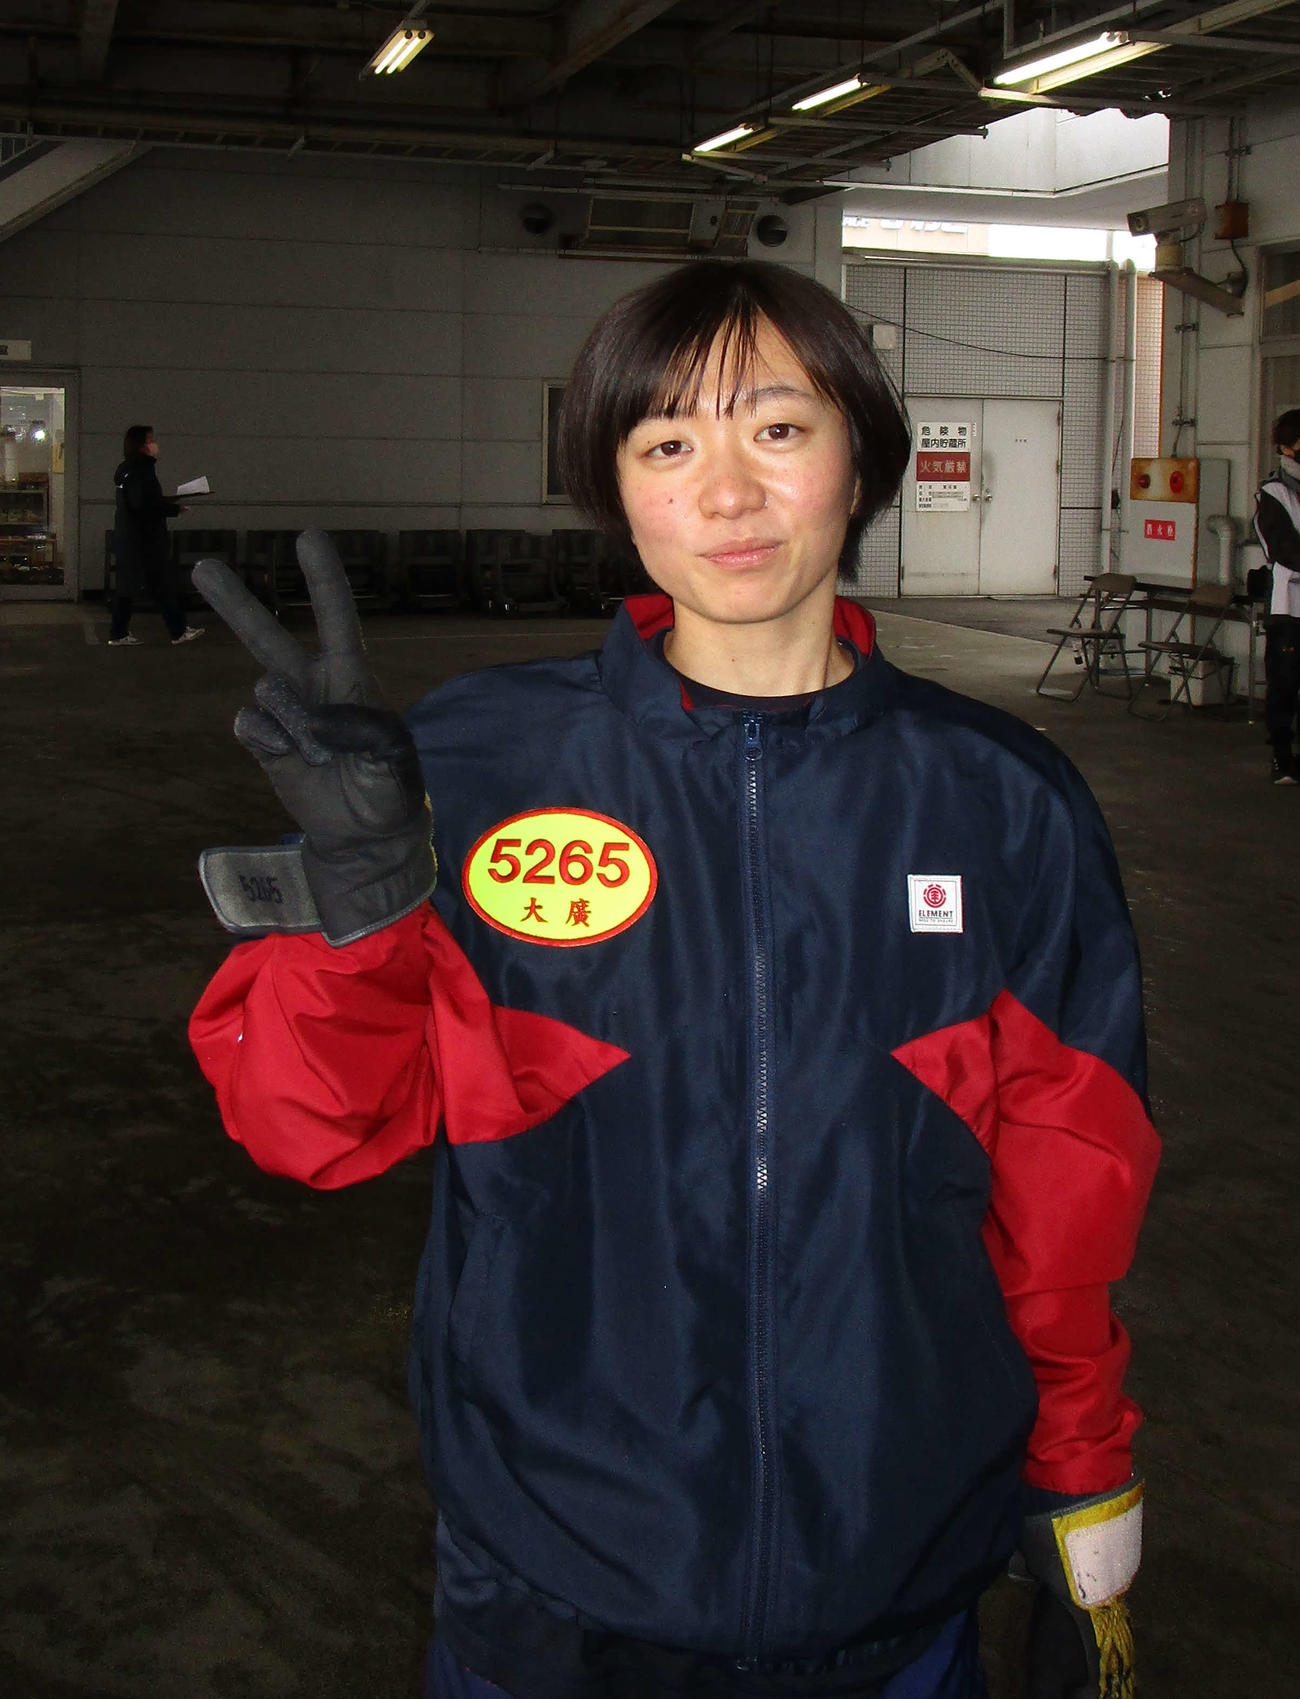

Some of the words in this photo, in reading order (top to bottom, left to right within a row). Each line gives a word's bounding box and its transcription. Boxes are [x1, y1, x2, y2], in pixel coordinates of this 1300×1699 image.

[922, 426, 967, 436] 危険物
[921, 438, 967, 448] 屋内貯蔵所
[920, 459, 968, 473] 火気厳禁
[487, 838, 630, 888] 5265
[520, 897, 591, 927] 大廣
[918, 909, 953, 917] ELEMENT
